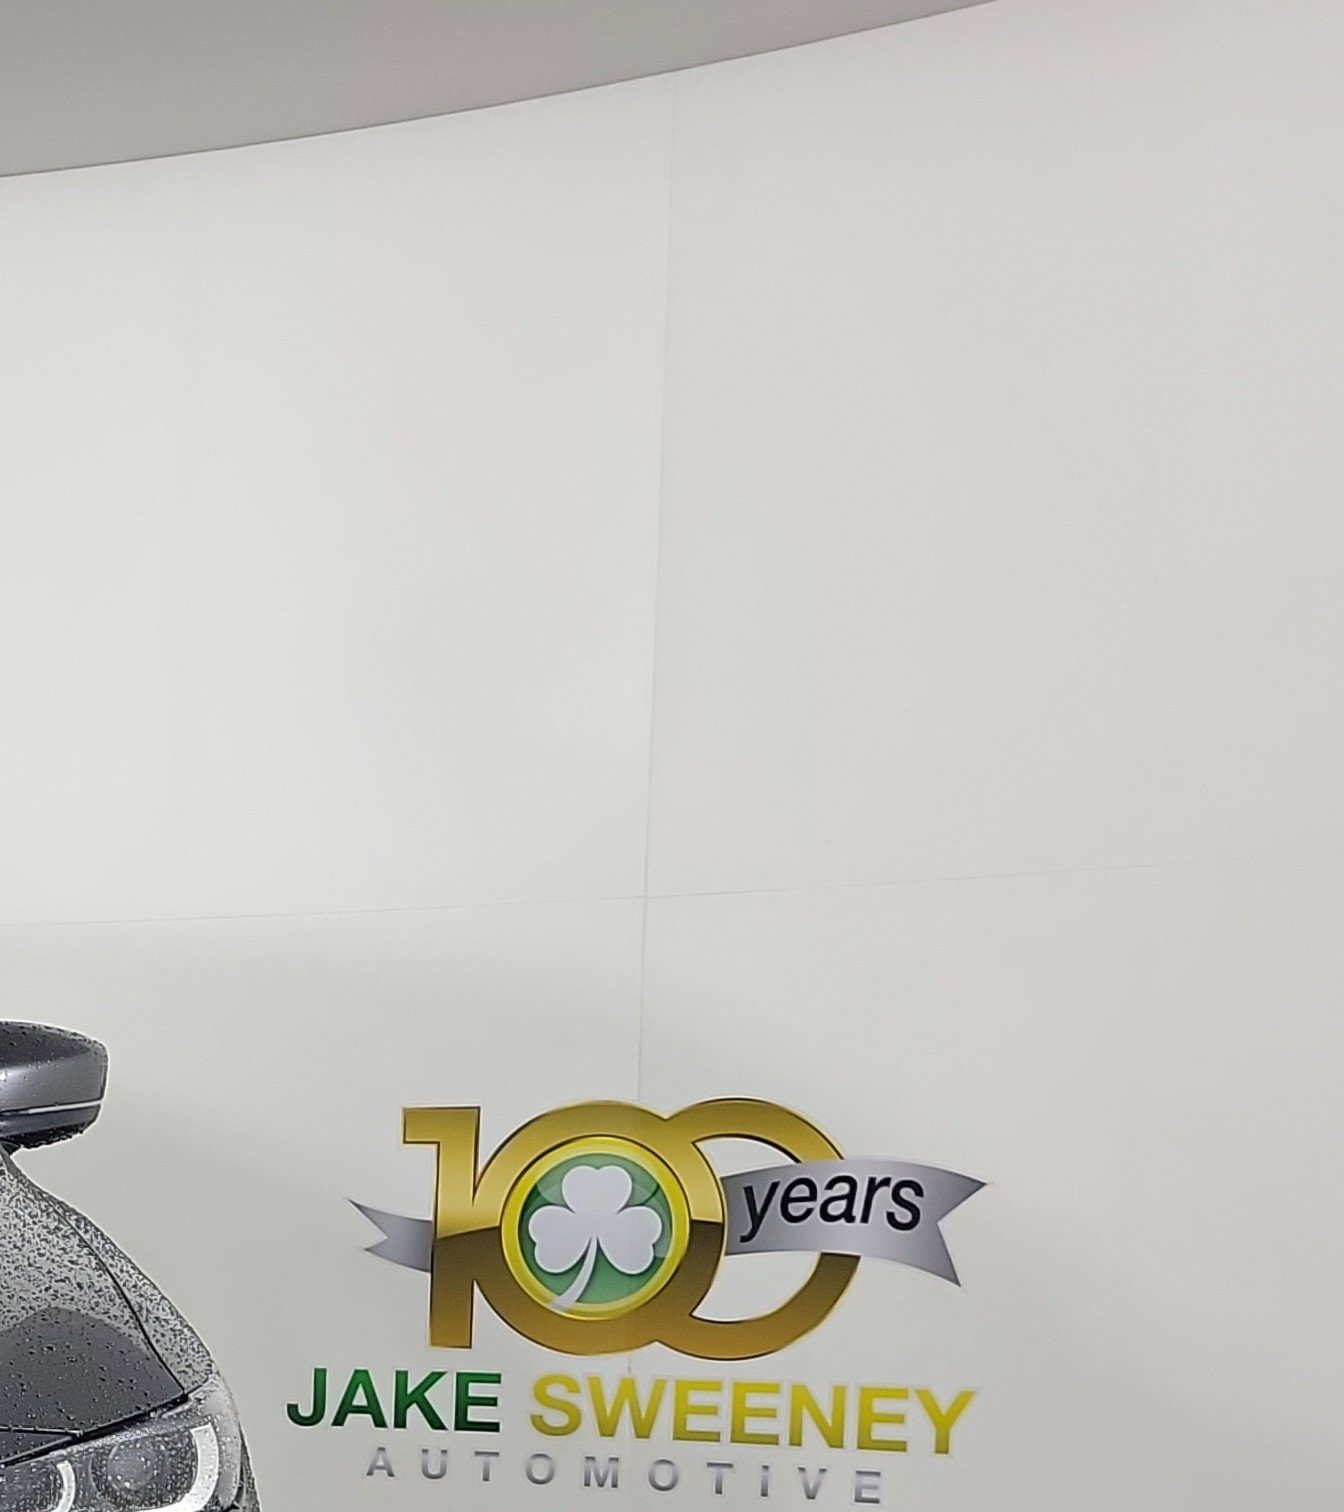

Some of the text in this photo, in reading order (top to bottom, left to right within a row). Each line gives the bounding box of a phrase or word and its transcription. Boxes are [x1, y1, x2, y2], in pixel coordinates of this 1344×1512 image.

[402, 1098, 925, 1361] 100 years
[286, 1367, 976, 1455] JAKE SWEENEY
[365, 1446, 882, 1504] AUTOMOTIVE
